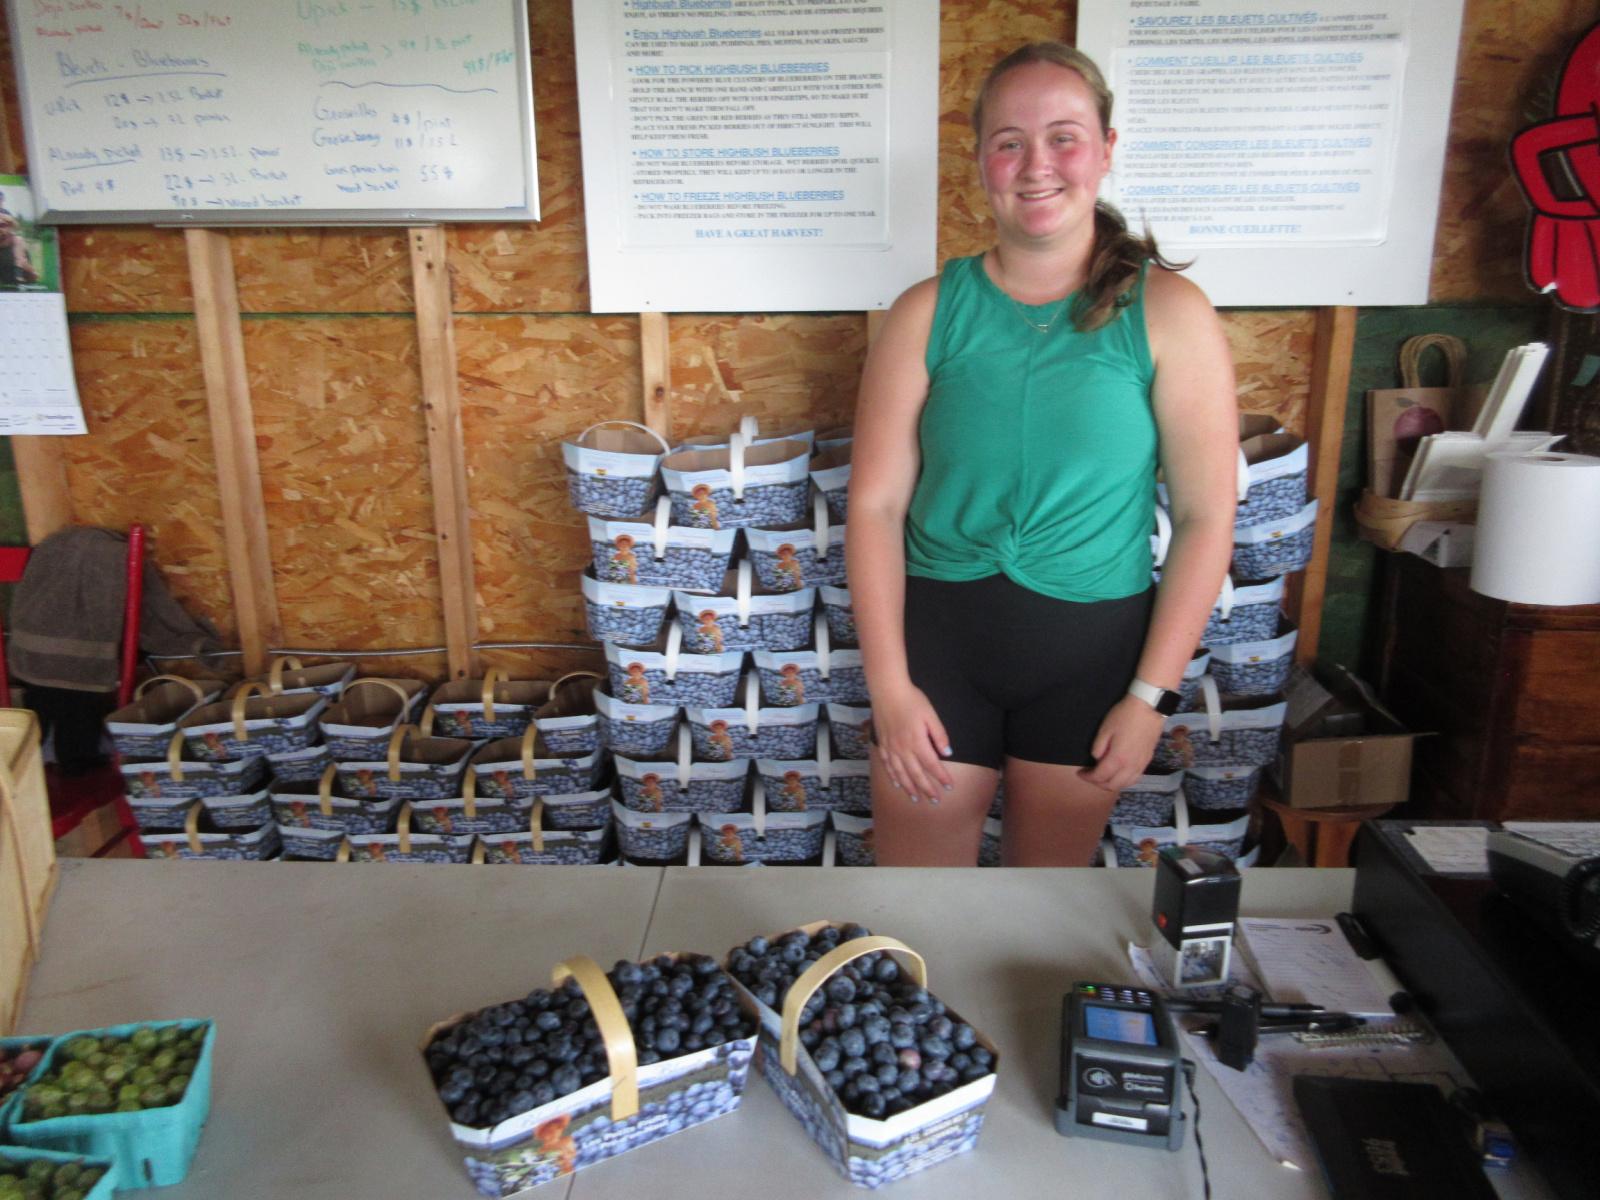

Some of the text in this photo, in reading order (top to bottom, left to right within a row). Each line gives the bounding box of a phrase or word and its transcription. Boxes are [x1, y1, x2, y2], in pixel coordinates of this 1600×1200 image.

[1137, 16, 1193, 26] SAVOUREZ
[1196, 16, 1214, 25] LES
[1218, 14, 1264, 24] BLEUETS
[662, 30, 706, 41] Highbush
[709, 28, 762, 38] Blueberries
[636, 62, 831, 75] HOW TO PICK HIGHBUSH BLUEBERRIES
[640, 146, 840, 158] HOW TO STORE HIGHBUSH BLUEBERRIES
[642, 190, 845, 202] HOW TO FREEZE HIGHBUSH BLUEBERRIES
[696, 228, 824, 238] HAVE A GREAT HARVEST!
